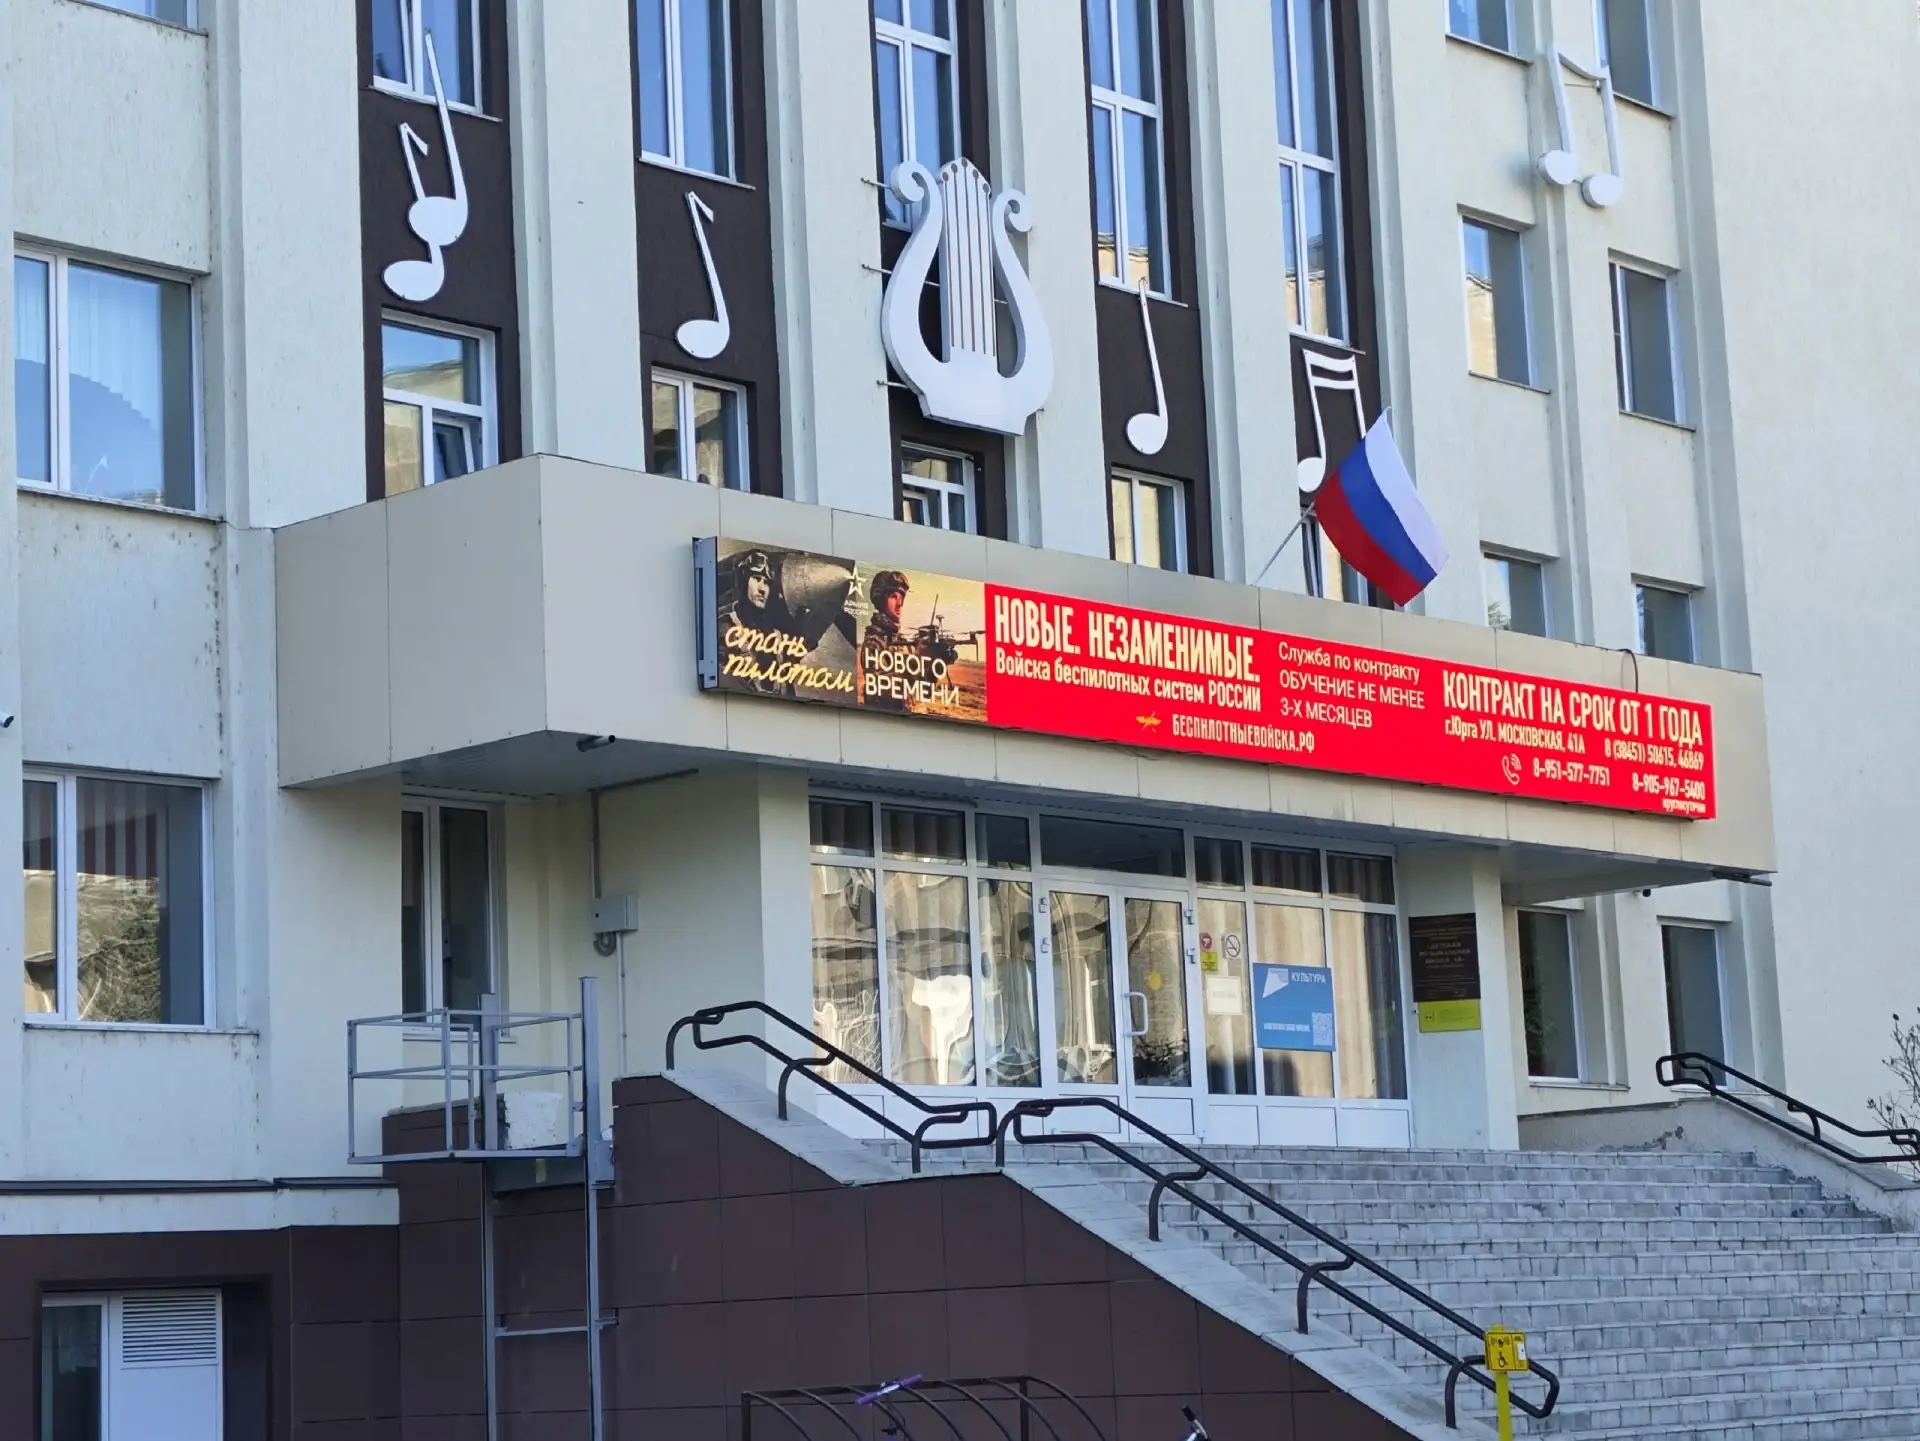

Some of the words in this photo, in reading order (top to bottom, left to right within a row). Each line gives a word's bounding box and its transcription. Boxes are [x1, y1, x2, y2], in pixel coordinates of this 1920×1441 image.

[994, 595, 1080, 654] НОВЫЕ.
[1088, 611, 1260, 682] НЕЗАМЕНИМЫЕ.
[723, 654, 854, 693] пилотом
[865, 649, 947, 680] НОВОГО
[996, 647, 1050, 681] Войска
[1055, 657, 1150, 696] беспилотных
[1154, 680, 1204, 704] систем
[1209, 680, 1261, 712] РОССИИ
[1279, 641, 1330, 667] Служба
[1334, 655, 1351, 671] по
[1354, 658, 1420, 686] контракту
[865, 673, 960, 707] ВРЕМЕНИ
[1279, 669, 1355, 699] ОБУЧЕНИЕ
[1358, 681, 1376, 701] НЕ
[1380, 686, 1425, 709] МЕНЕЕ
[1443, 670, 1536, 719] КОНТРАКТ
[1540, 686, 1565, 725] НА
[1569, 691, 1616, 733] СРОК
[1620, 699, 1641, 737] ОТ
[1644, 703, 1654, 739] 1
[1659, 706, 1703, 747] ГОДА
[1280, 698, 1302, 718] 3-Х
[1306, 701, 1372, 729] МЕСЯЦЕВ
[1172, 714, 1315, 753] БЕСПИЛОТНЫЕВОЙСКА.РФ
[1445, 715, 1478, 742] г.Юрга
[1498, 722, 1566, 752] МОСКОВСКАЯ,
[1604, 738, 1611, 758] 8
[1291, 972, 1327, 985] КУЛЬТУРА
